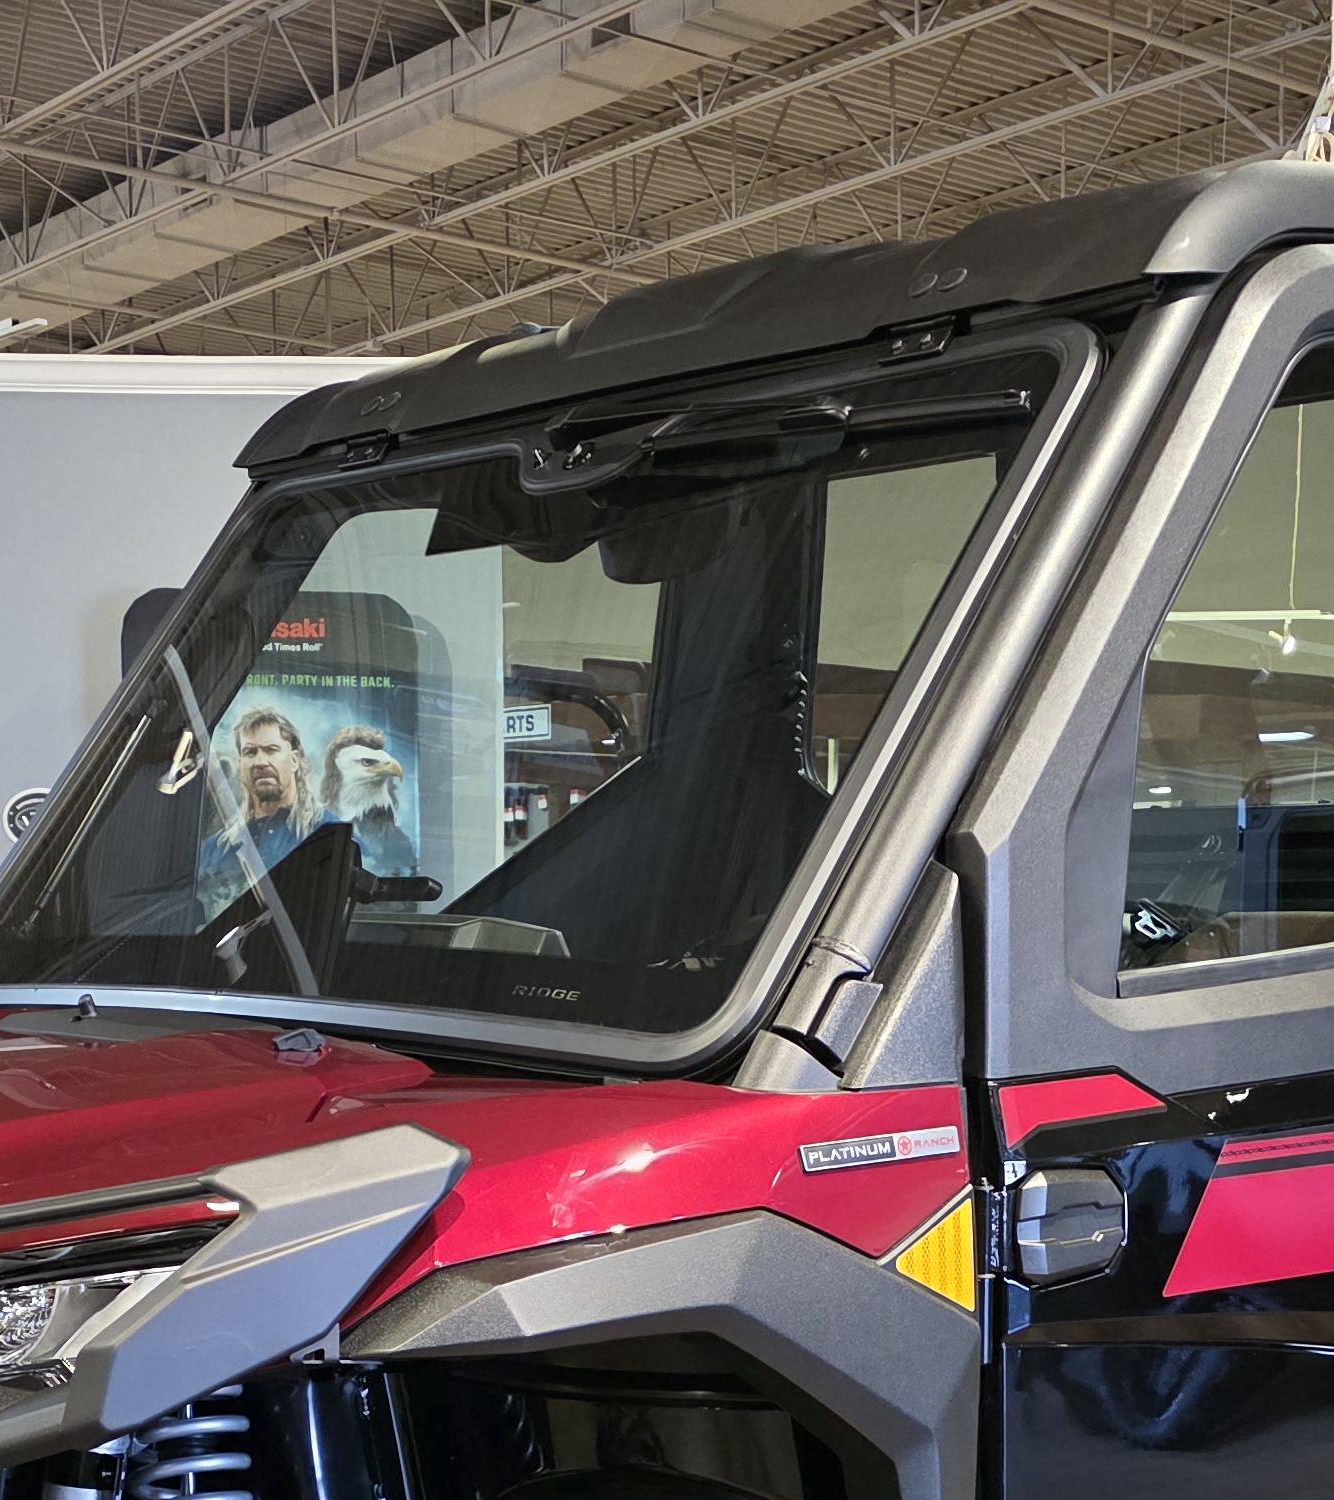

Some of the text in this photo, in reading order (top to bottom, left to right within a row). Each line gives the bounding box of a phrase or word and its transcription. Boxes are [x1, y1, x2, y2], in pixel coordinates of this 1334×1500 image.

[270, 617, 327, 638] saki
[273, 642, 302, 653] Times
[246, 674, 396, 689] RONT. PARTY IN THE BACK.
[505, 714, 535, 734] RTS
[511, 984, 582, 1002] RIDGE
[808, 1135, 955, 1165] PLATINUM RANCH
